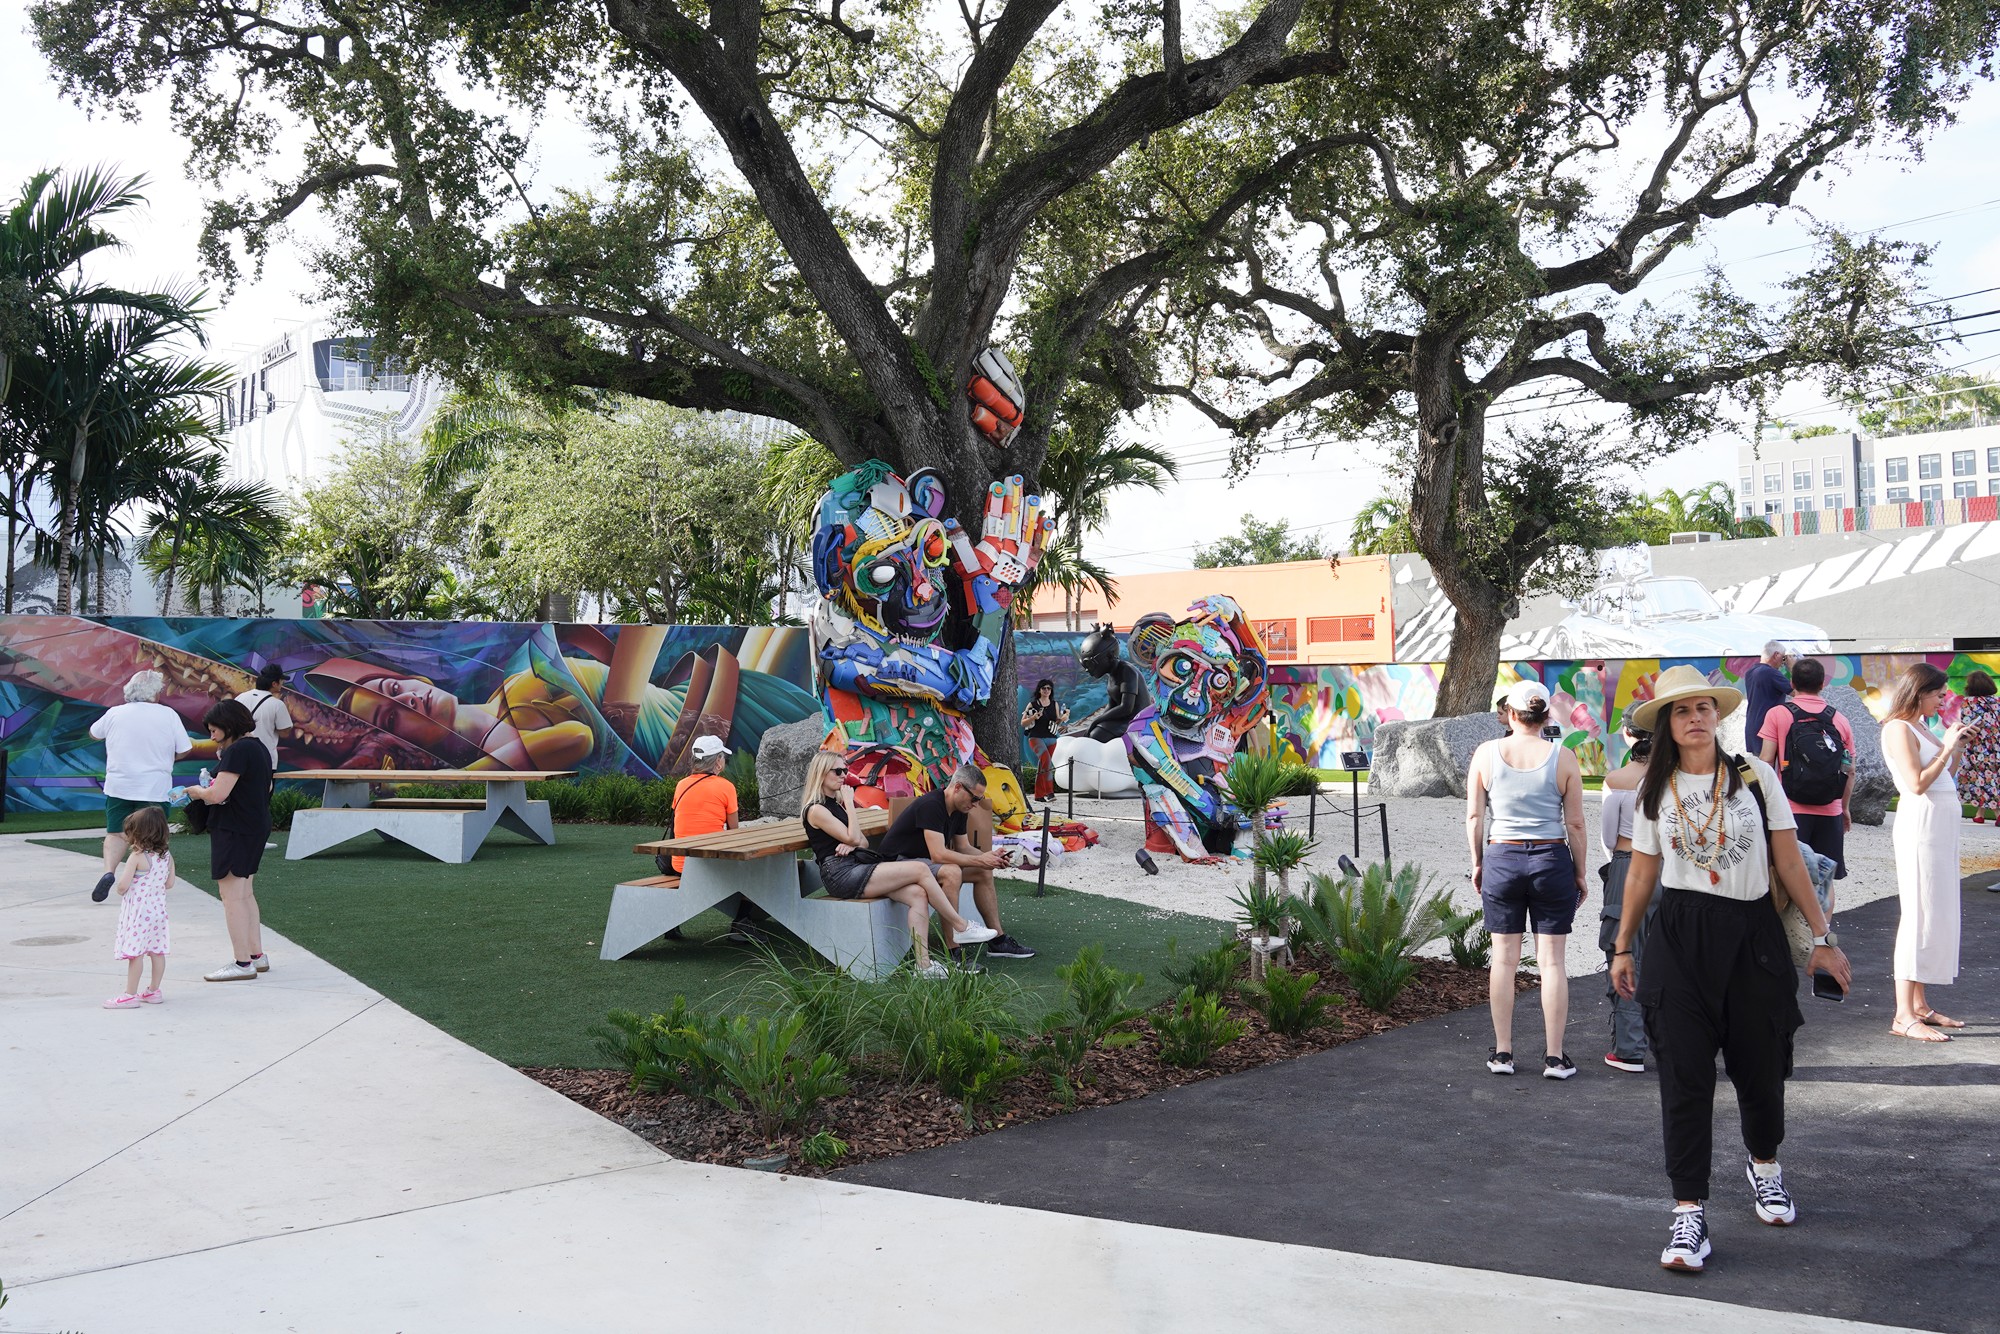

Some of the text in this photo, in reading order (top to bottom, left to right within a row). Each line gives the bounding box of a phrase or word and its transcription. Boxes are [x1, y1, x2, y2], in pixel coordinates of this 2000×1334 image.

[1703, 789, 1727, 804] WHT
[1735, 834, 1754, 853] NOT
[1728, 846, 1744, 866] ARE
